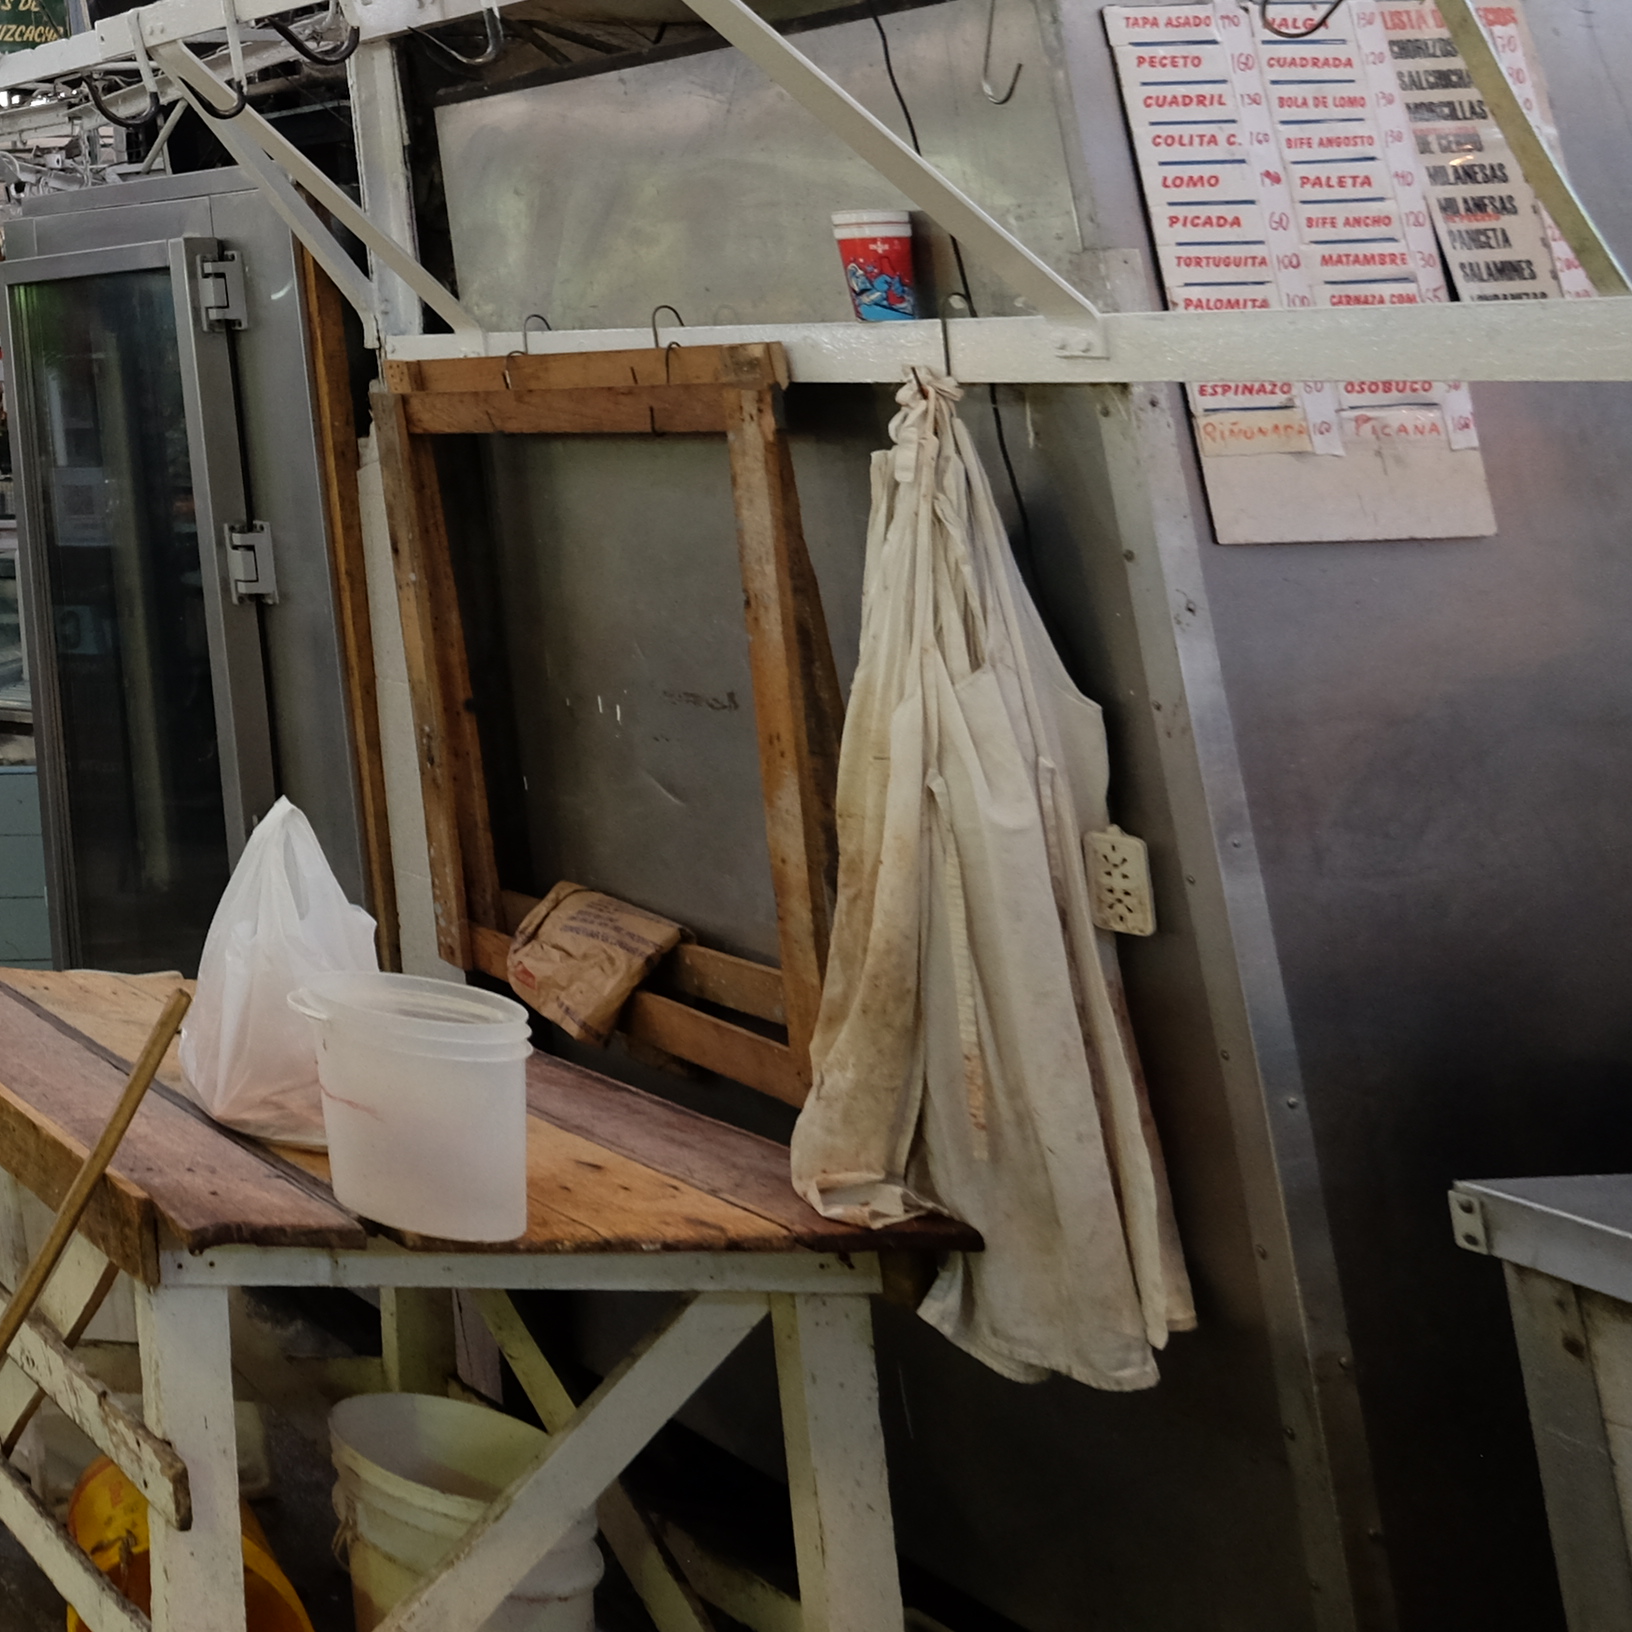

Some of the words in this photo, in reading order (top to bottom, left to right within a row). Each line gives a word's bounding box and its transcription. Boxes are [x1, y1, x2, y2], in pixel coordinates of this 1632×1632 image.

[1124, 15, 1160, 29] TAPA
[1164, 15, 1214, 28] ASADO
[1136, 54, 1203, 69] PECETO
[1266, 56, 1354, 69] CUADRADA
[1143, 94, 1227, 108] CUADRIL
[1332, 96, 1367, 109] LOMO
[1152, 133, 1219, 147] COLITA
[1317, 135, 1375, 148] ANGOSTO
[1161, 174, 1220, 188] LOMO
[1299, 175, 1373, 188] PALETA
[1167, 215, 1242, 228] PICADA
[1305, 216, 1338, 229] BIFE
[1342, 215, 1392, 228] ANCHO
[1175, 255, 1269, 268] TORTUGUITA
[1320, 253, 1408, 267] MATAMBRE
[1184, 297, 1270, 310] PALOMITA
[1198, 382, 1293, 397] ESPINAZO
[1343, 380, 1434, 395] OSOBUCO
